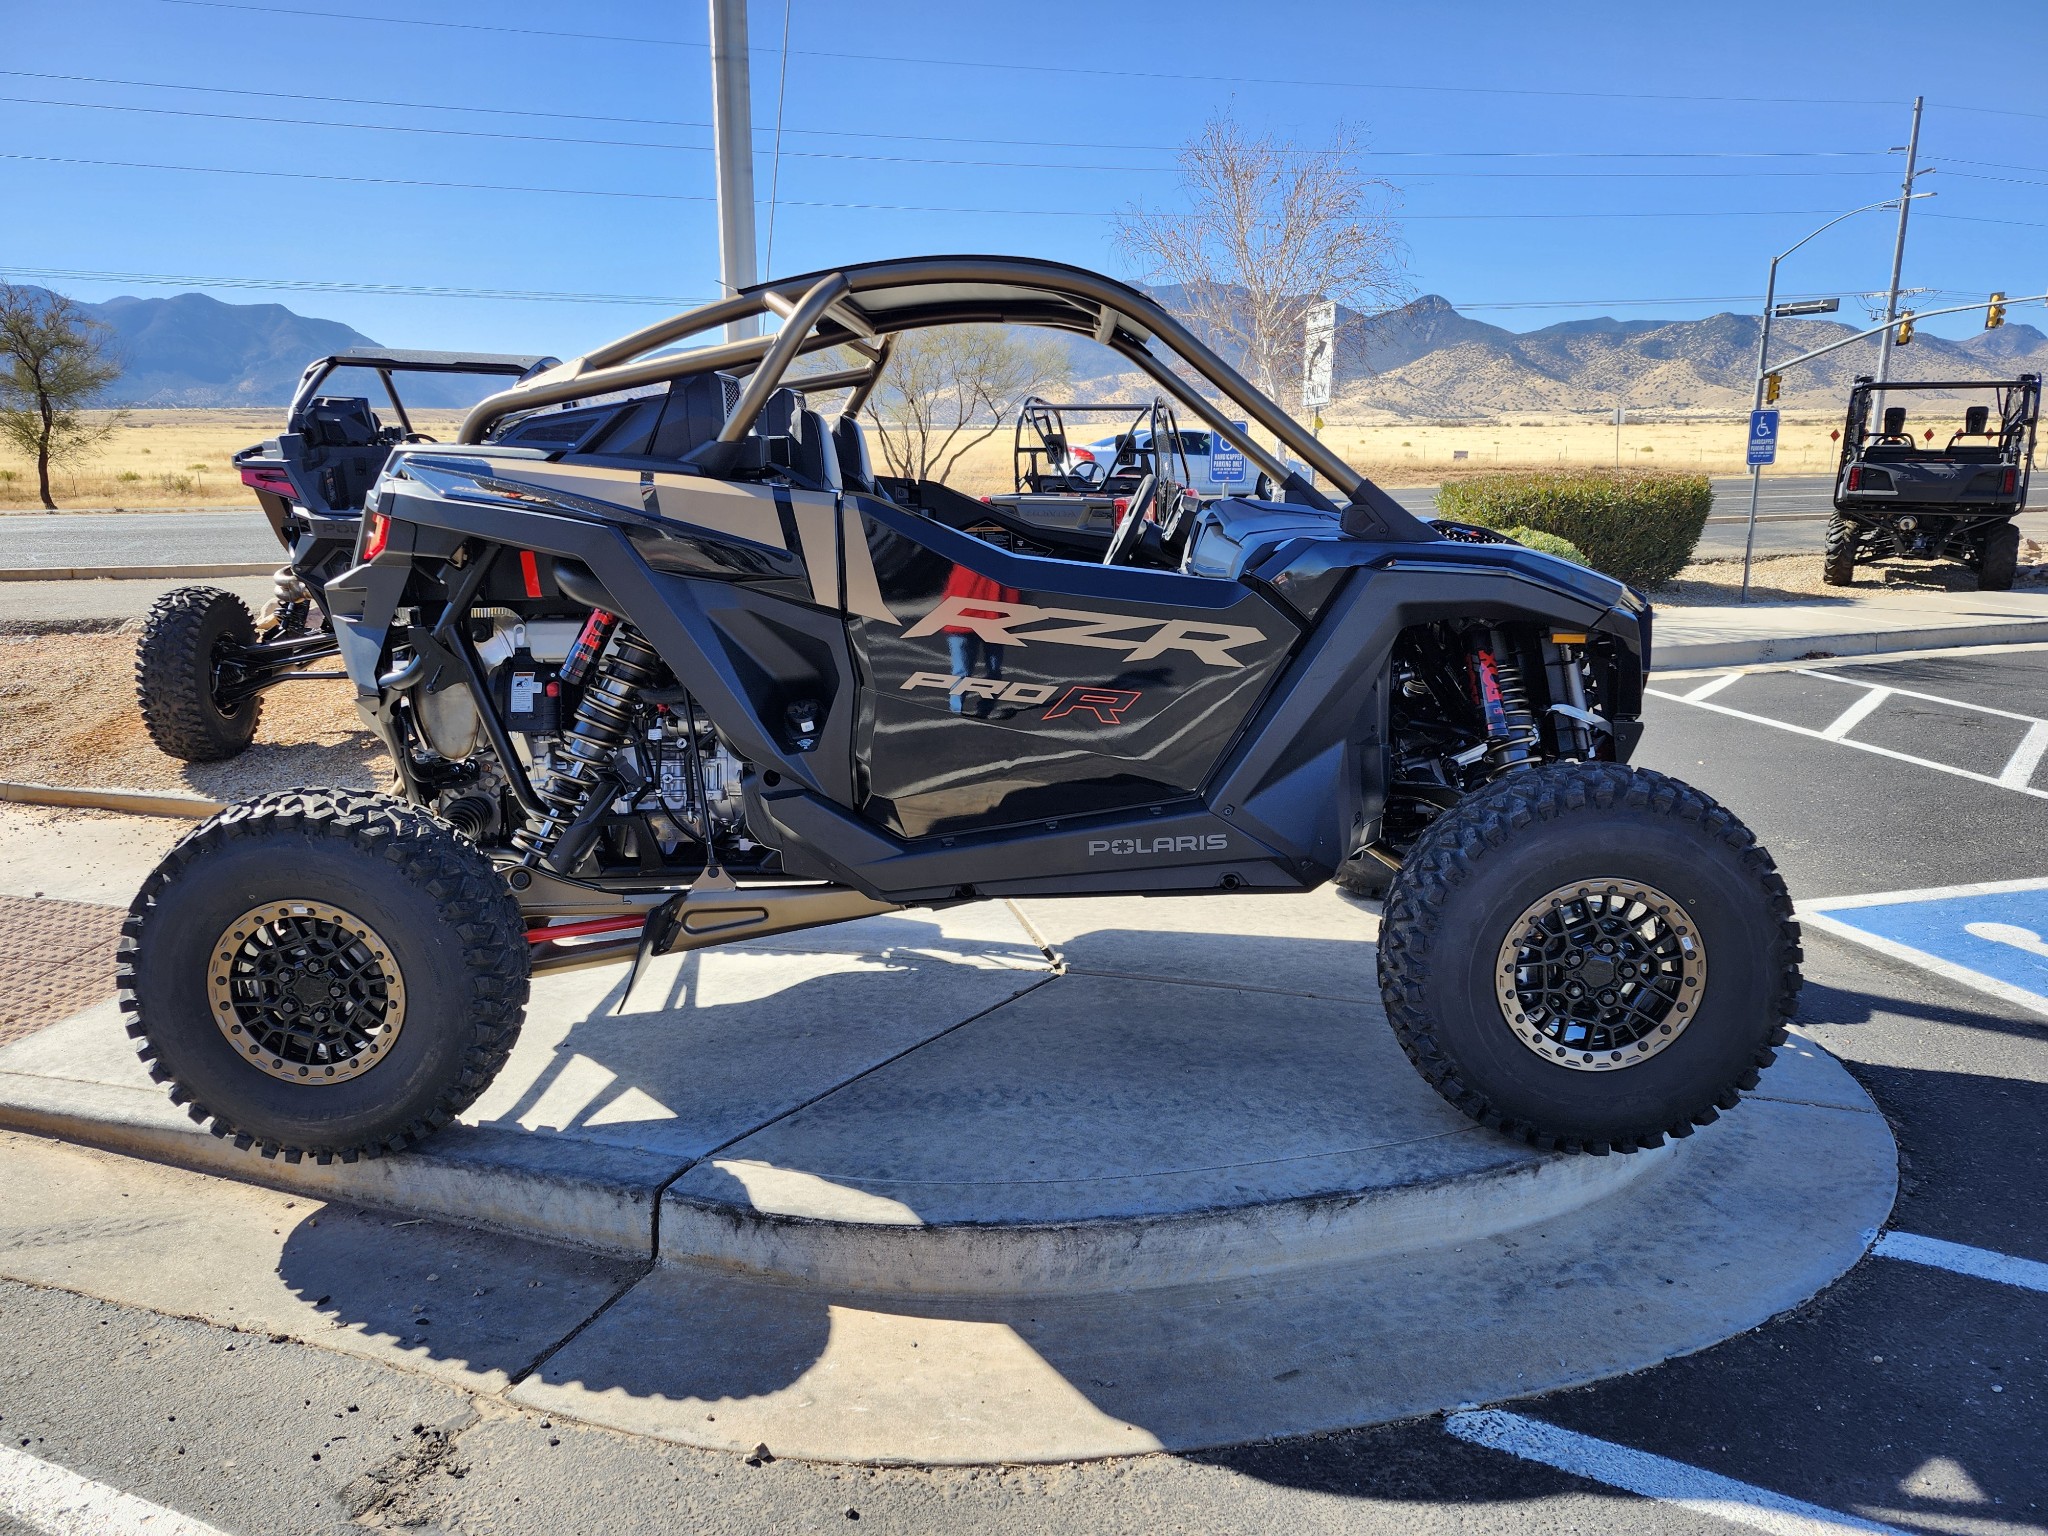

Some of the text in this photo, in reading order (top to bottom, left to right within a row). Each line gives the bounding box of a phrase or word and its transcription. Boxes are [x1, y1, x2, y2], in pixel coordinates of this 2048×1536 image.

[900, 596, 1267, 668] RZR
[900, 671, 1142, 725] PRO R
[1088, 833, 1228, 856] POLARIS
